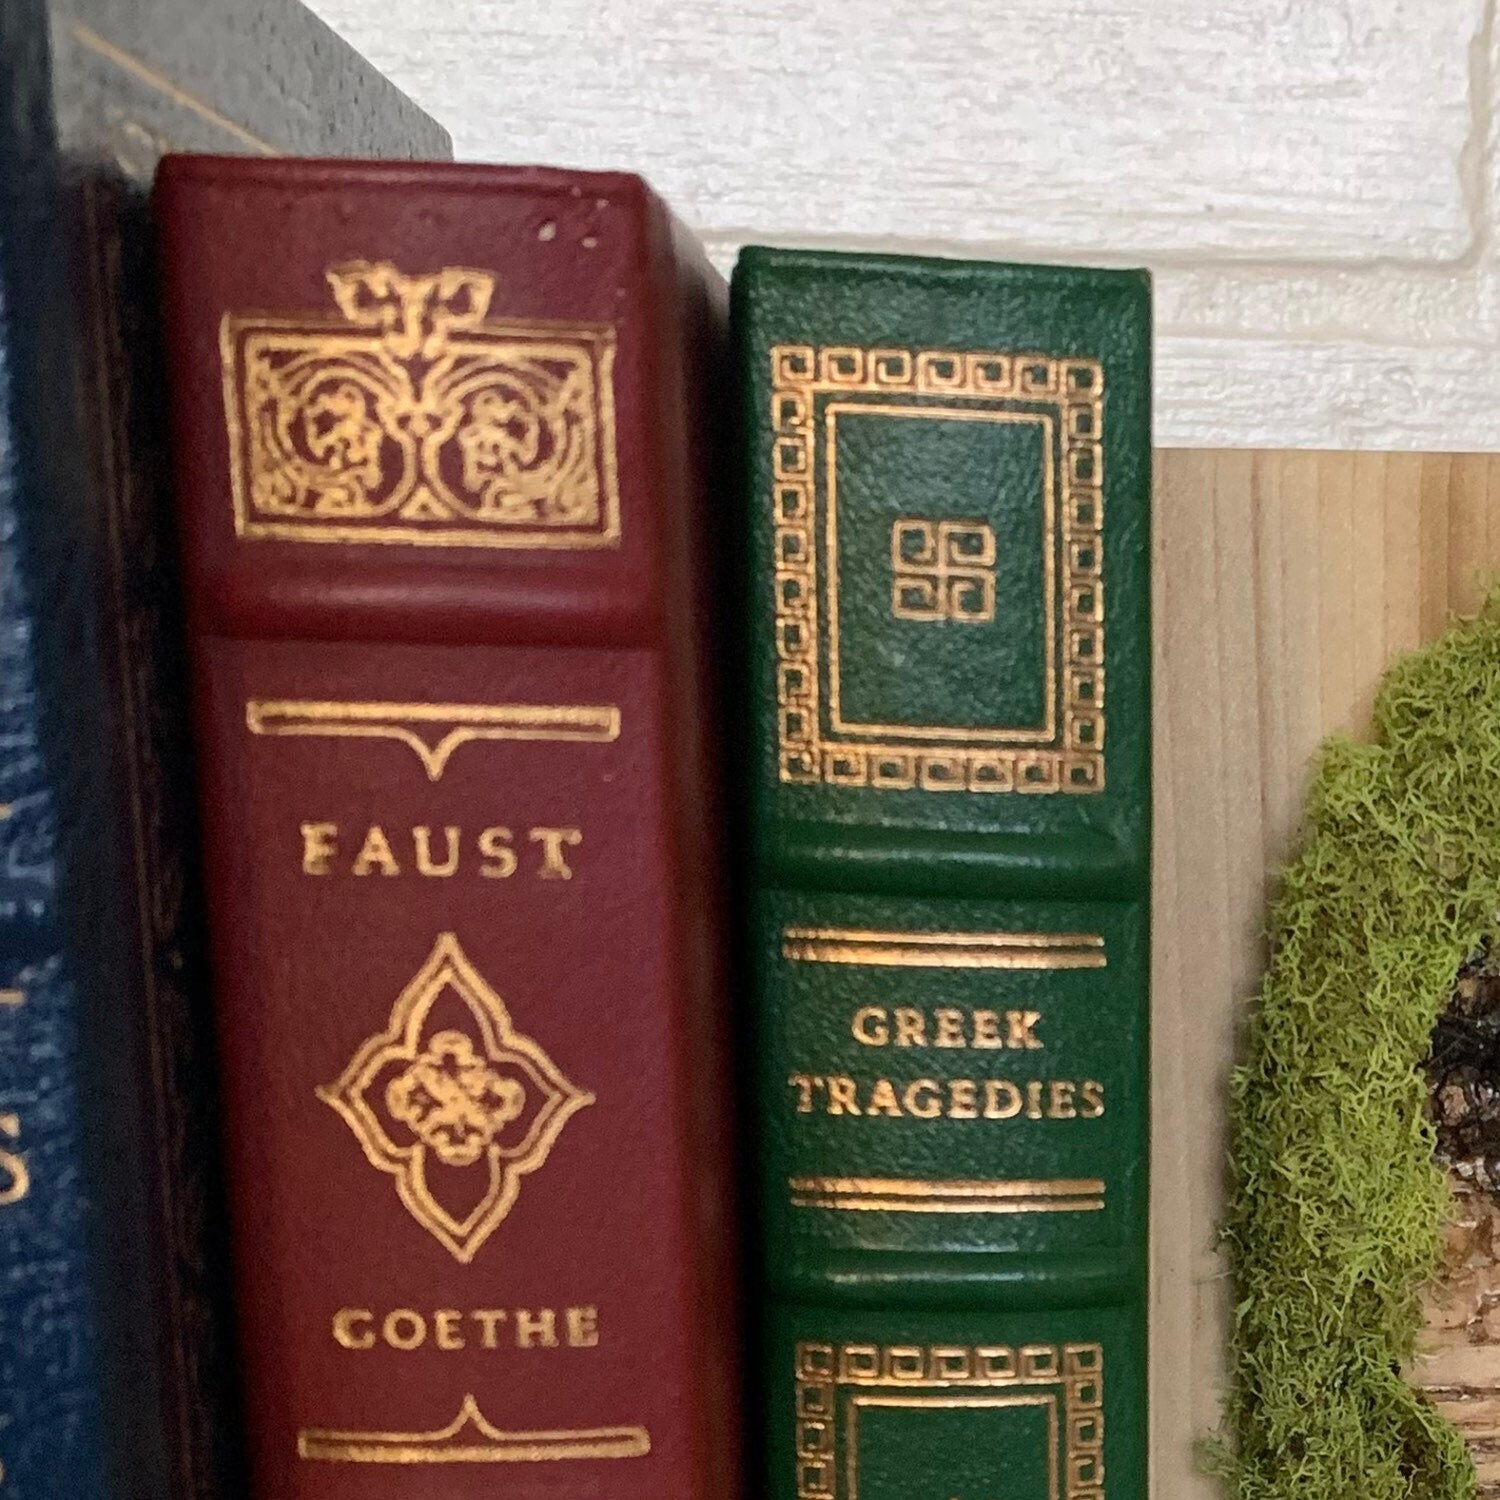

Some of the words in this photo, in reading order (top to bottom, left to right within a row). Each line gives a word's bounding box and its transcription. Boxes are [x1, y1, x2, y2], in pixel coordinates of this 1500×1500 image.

[300, 822, 583, 880] FAUST
[851, 1005, 1044, 1050] GREEK
[787, 1073, 1105, 1120] TRAGEDIES
[332, 1308, 599, 1350] GOETHE
